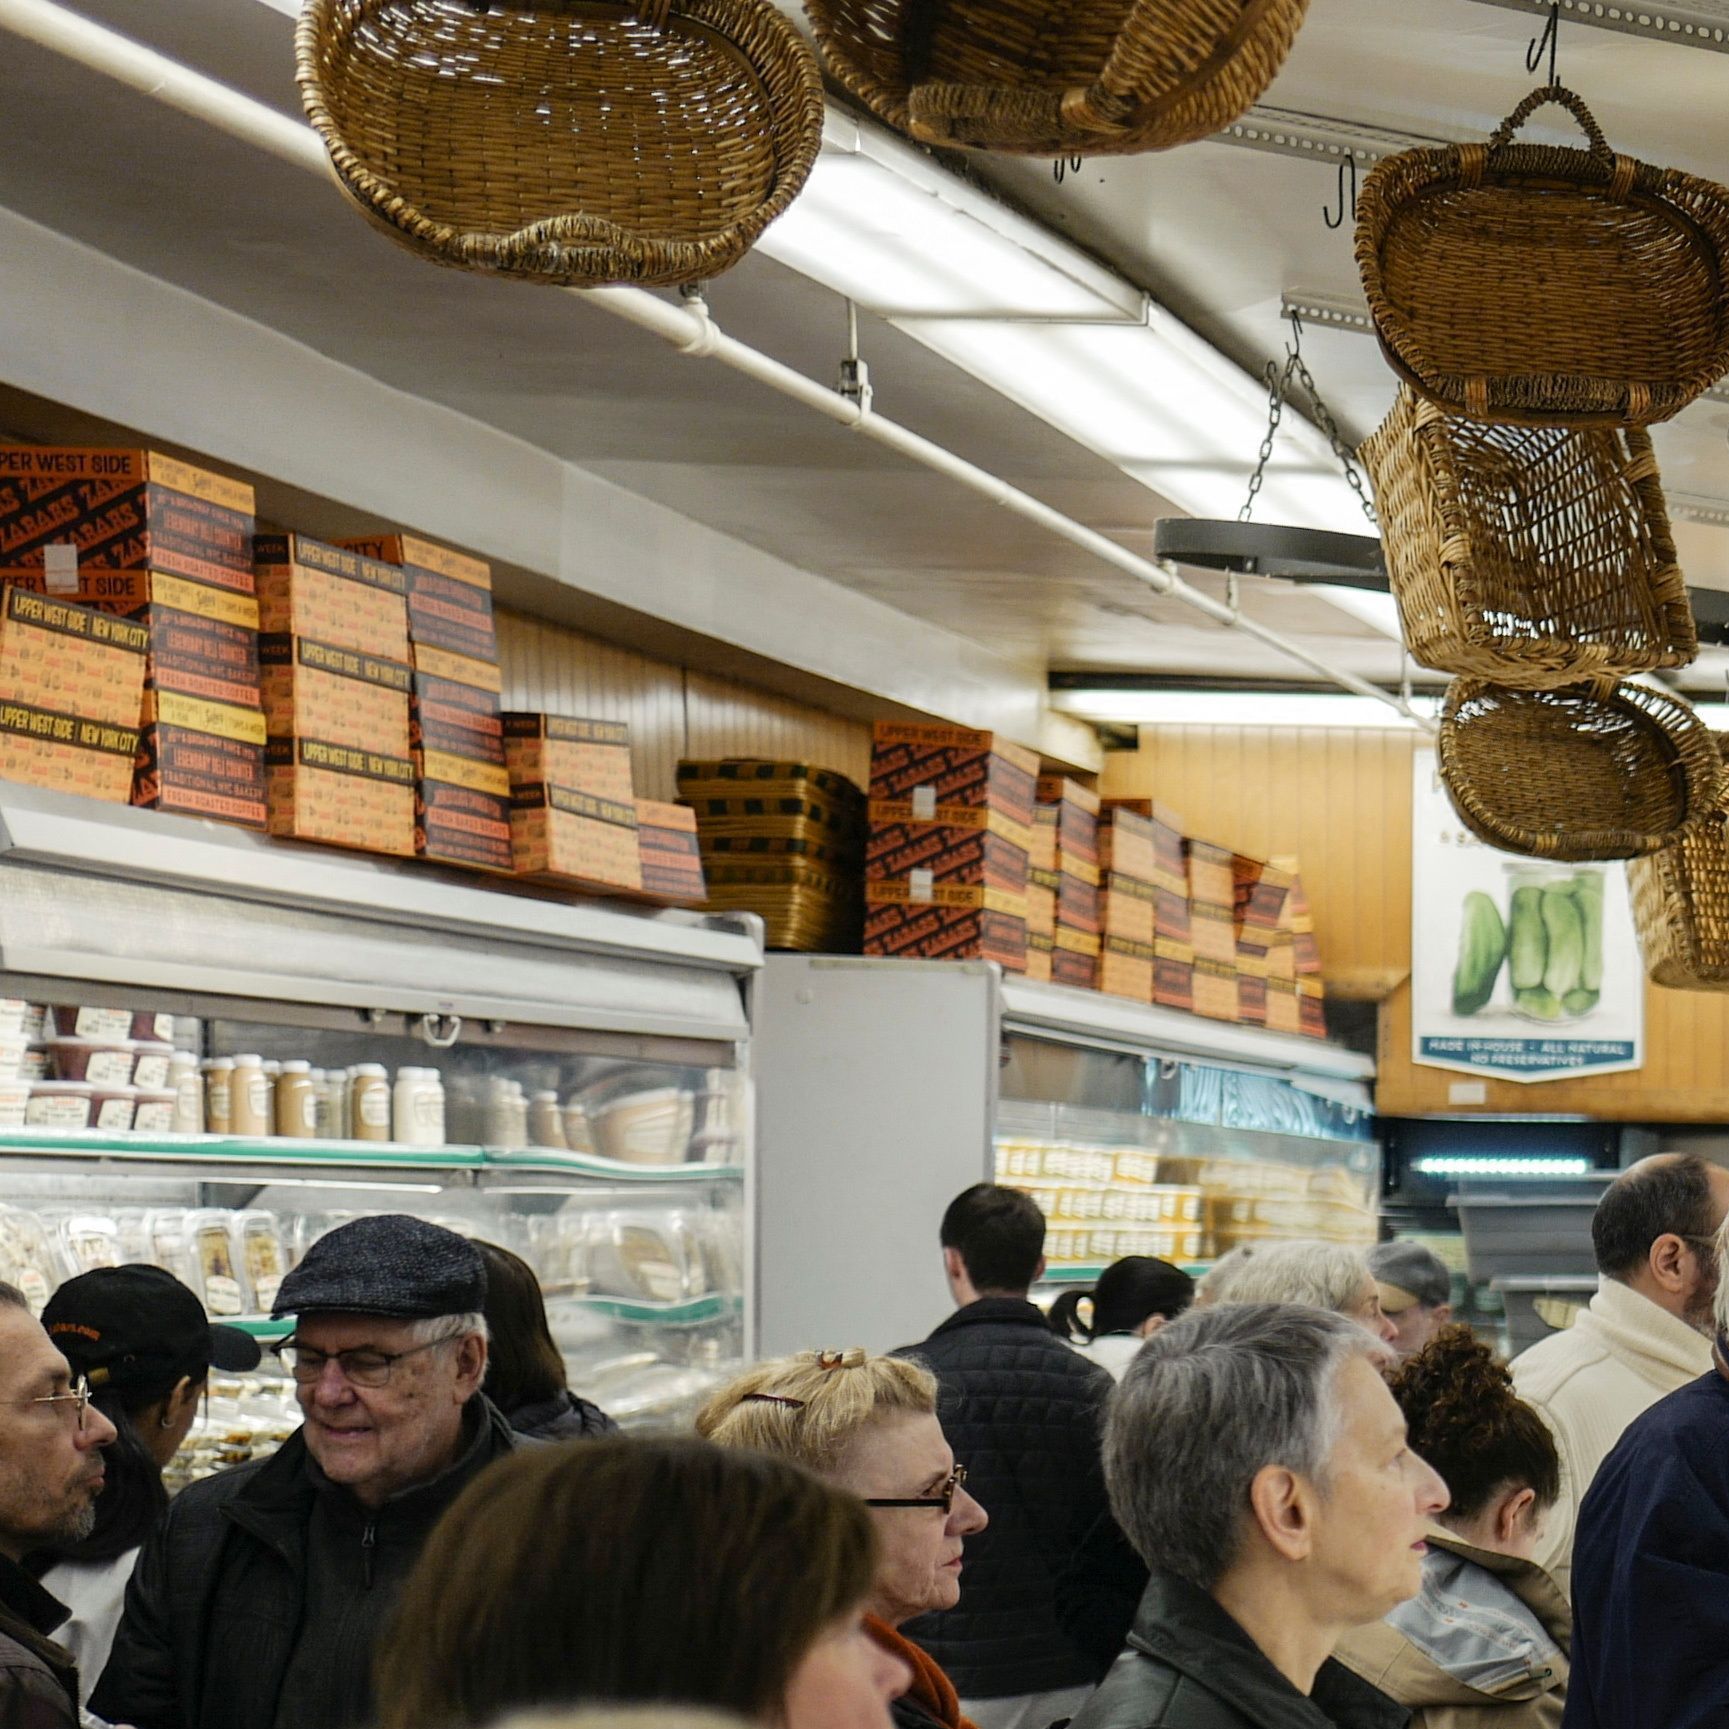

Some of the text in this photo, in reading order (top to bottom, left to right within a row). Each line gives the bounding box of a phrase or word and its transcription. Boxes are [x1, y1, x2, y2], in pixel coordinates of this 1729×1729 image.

[36, 454, 87, 472] WEST
[91, 455, 132, 473] SIDE
[14, 596, 149, 648] UPPER WEST SIDE NEW YORK CITY
[1429, 1041, 1463, 1052] MADE
[1541, 1042, 1564, 1053] ALL
[1567, 1043, 1626, 1055] NATURAL
[1470, 1053, 1584, 1067] NO PRESERVATIVES
